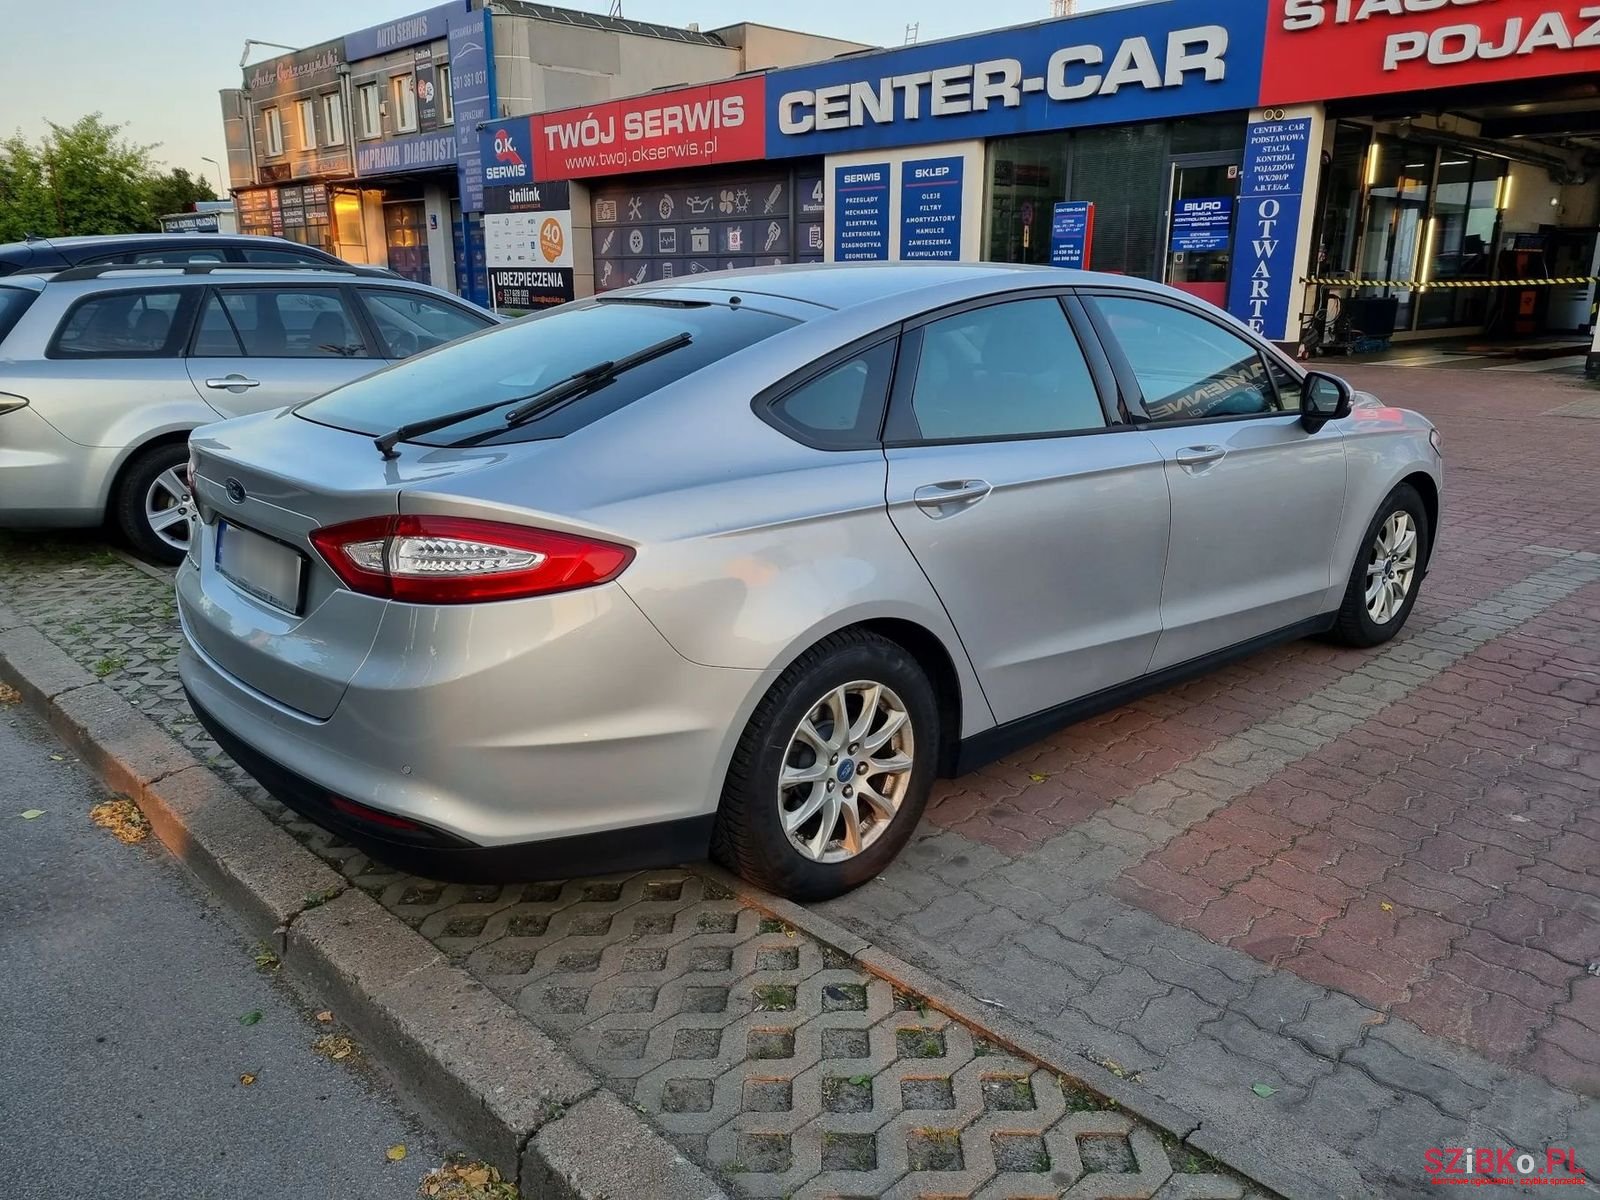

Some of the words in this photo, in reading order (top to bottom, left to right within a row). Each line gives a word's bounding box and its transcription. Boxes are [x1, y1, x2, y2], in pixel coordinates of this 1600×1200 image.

[1283, 0, 1488, 31] STA
[377, 25, 396, 49] AUTO
[397, 16, 428, 43] SERWIS
[251, 68, 277, 90] Auto
[778, 25, 1229, 136] CENTER-CAR
[544, 112, 615, 151] TWÓJ
[624, 96, 745, 141] SERWIS
[1253, 126, 1283, 134] CENTER
[1288, 123, 1305, 131] CAR
[1251, 134, 1305, 144] PODSTAWOWA
[494, 136, 517, 154] O.K.
[1262, 145, 1290, 153] STACJA
[359, 145, 401, 170] NAPRAWA
[565, 136, 718, 170] www.twoj.okserwis.pl
[1256, 154, 1295, 163] KONTROLI
[915, 167, 950, 178] SKLEP
[1253, 162, 1295, 173] POJAZDÓW
[844, 172, 881, 183] SERWIS
[509, 187, 540, 203] Unilink
[845, 196, 879, 204] PRZEGLĄDY
[921, 192, 941, 200] OLEJE
[845, 208, 879, 216] MECHANIKA
[1183, 201, 1221, 212] BIURO
[906, 215, 956, 223] AMORTYZATORY
[543, 223, 560, 244] 40
[842, 230, 881, 238] ELEKTRONIKA
[915, 227, 945, 235] HAMULCE
[497, 271, 564, 287] UBEZPIECZENIA
